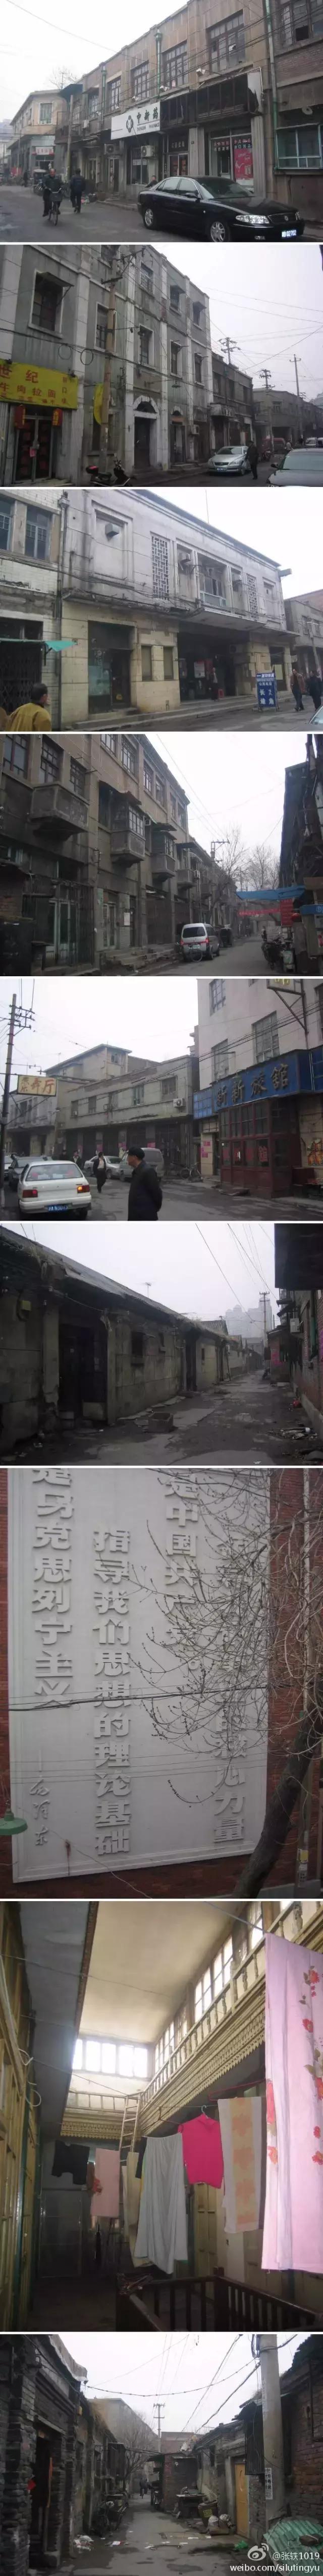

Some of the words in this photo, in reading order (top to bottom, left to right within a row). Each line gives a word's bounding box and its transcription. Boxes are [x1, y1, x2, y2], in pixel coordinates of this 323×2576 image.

[31, 1469, 74, 1708] 是马克思列宁主义
[93, 1529, 132, 1855] 指导我们思想的理论基础
